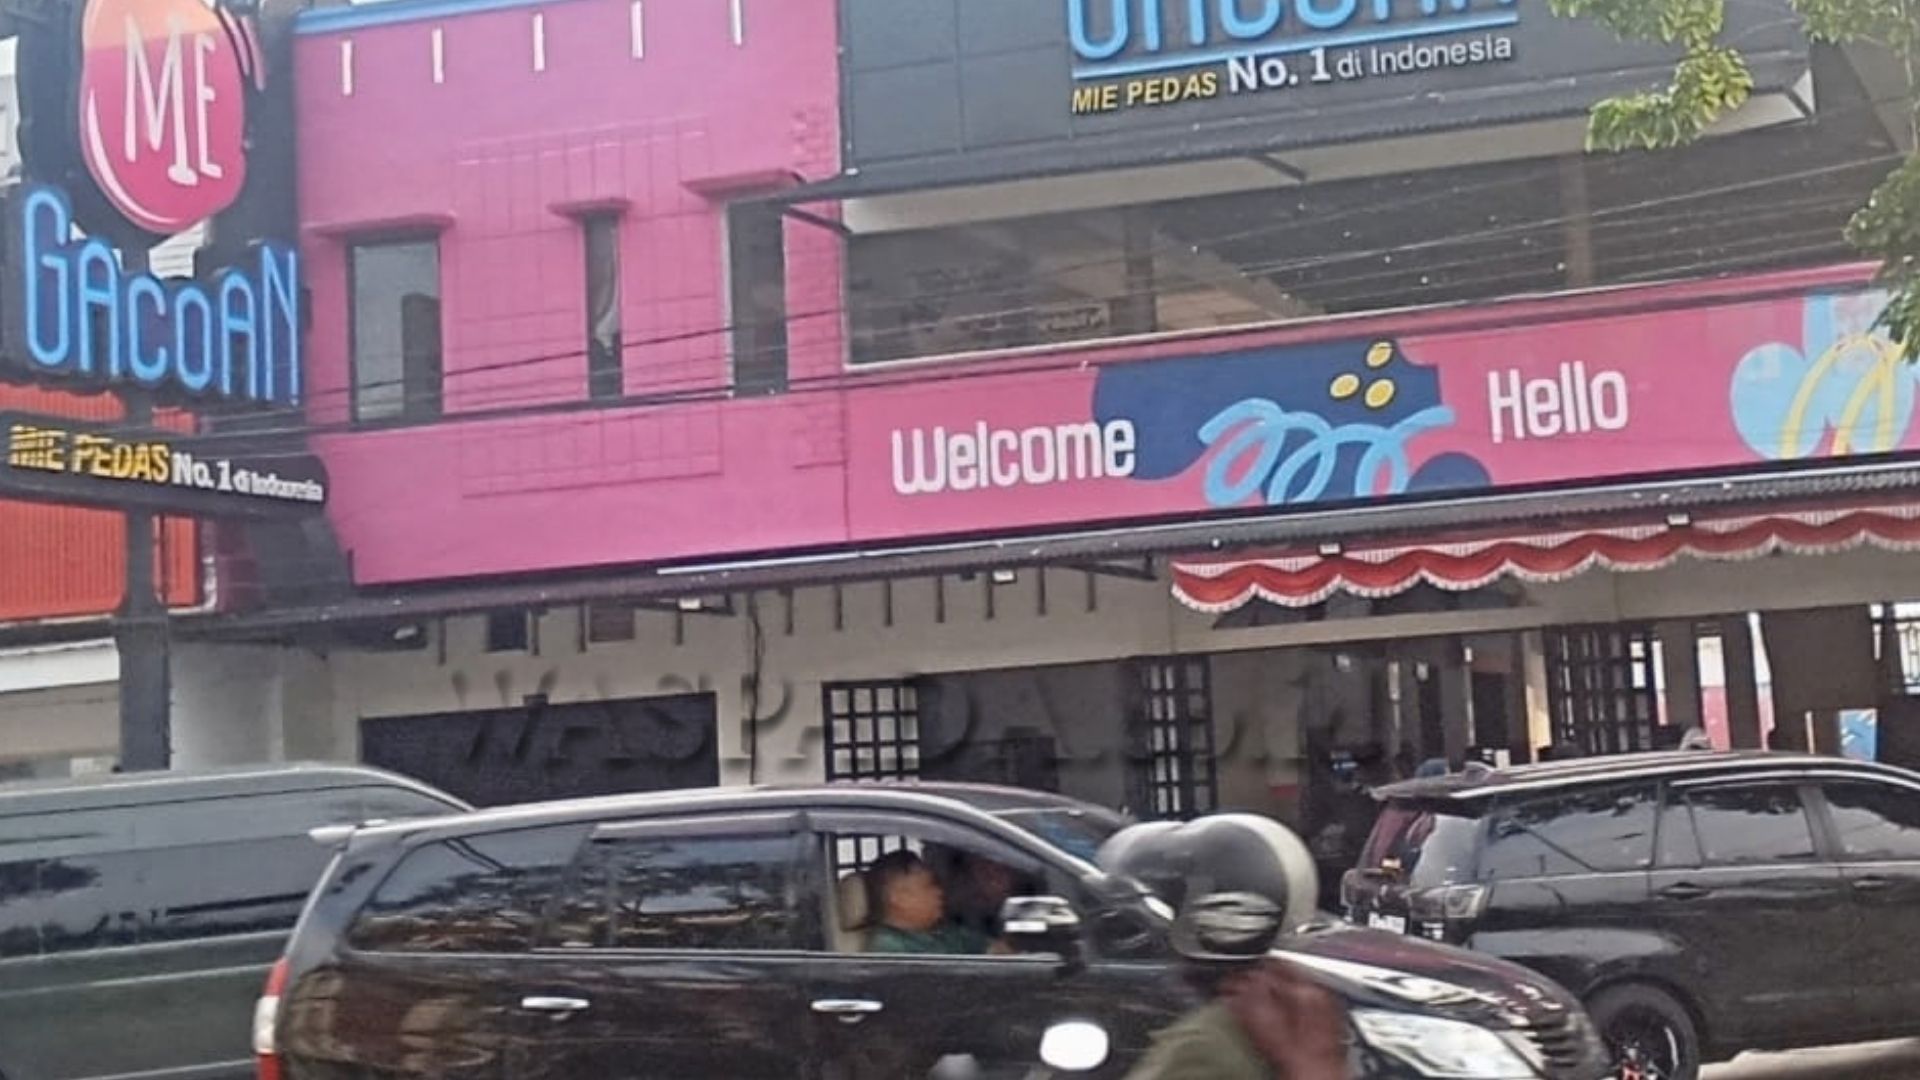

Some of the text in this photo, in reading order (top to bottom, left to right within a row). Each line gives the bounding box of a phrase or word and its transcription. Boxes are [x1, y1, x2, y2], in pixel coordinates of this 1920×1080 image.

[1071, 33, 1513, 115] MIE PEDAS No. 1 di Indonesia
[24, 190, 300, 407] GACOAN
[1486, 359, 1629, 444] Hello
[9, 425, 67, 471] MIE
[71, 434, 170, 483] PEDAS
[891, 418, 1137, 495] Welcome
